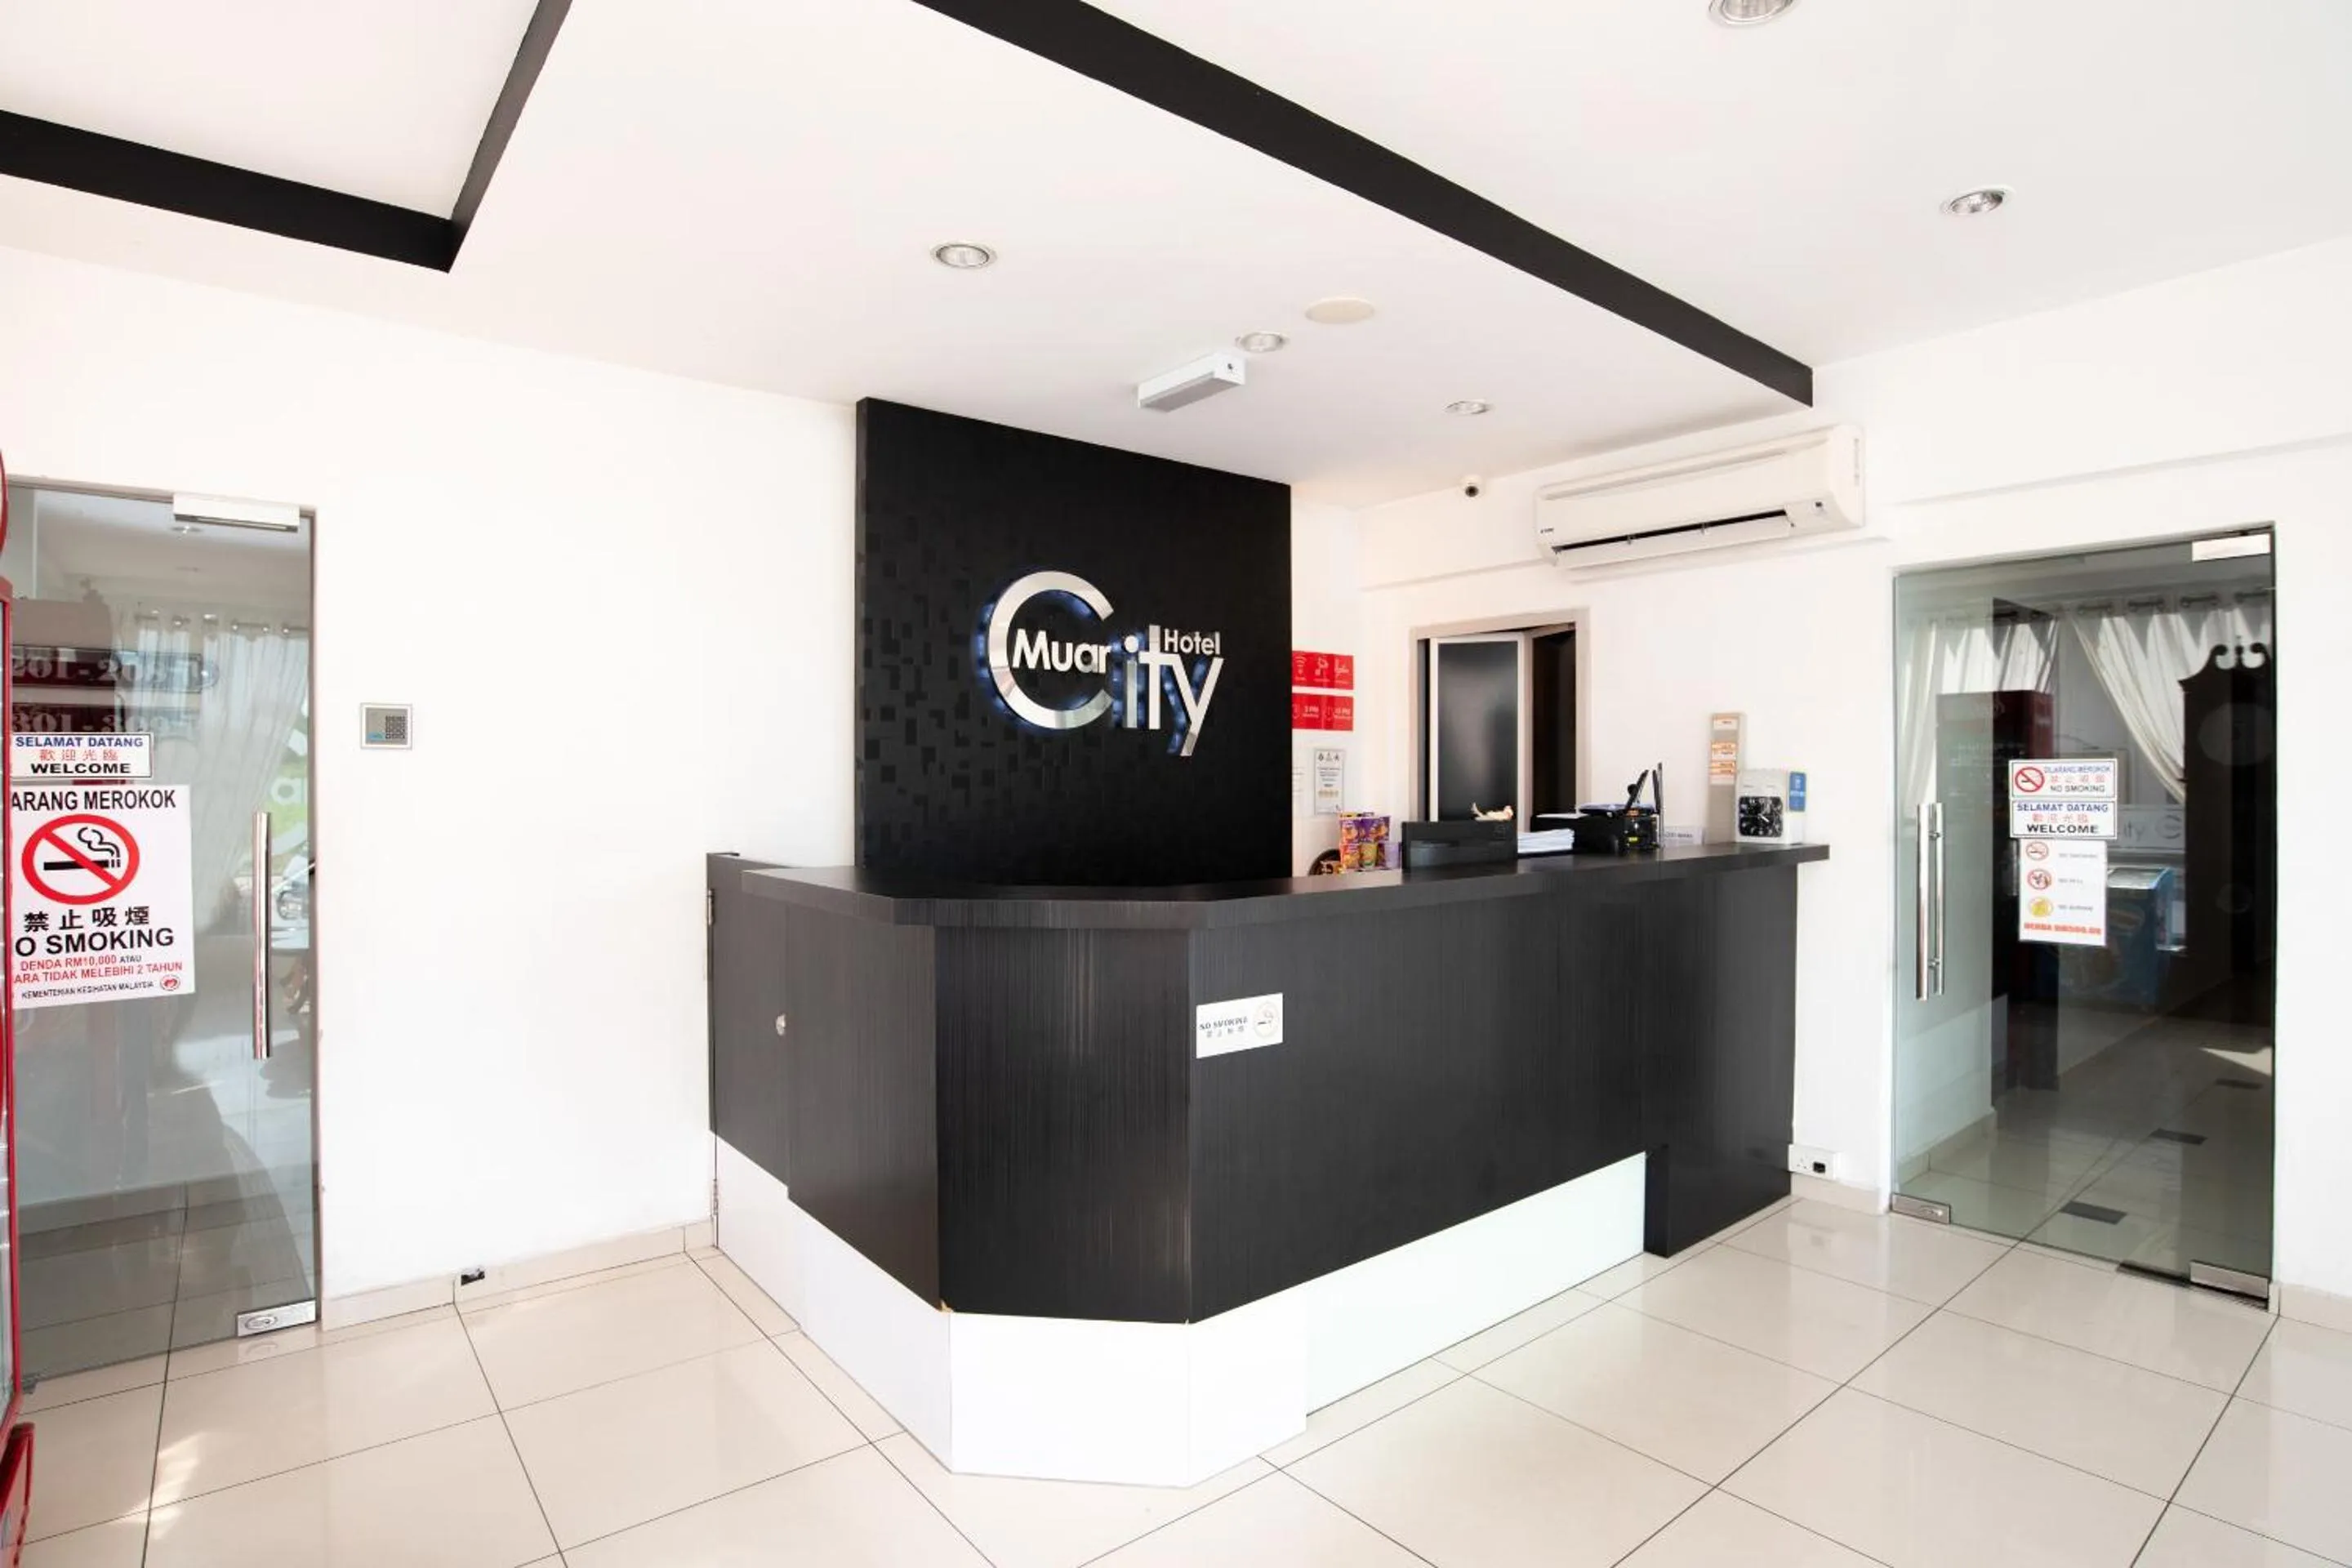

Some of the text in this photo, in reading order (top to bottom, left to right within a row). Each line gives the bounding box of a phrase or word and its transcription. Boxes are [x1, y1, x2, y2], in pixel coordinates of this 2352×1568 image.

[1013, 629, 1111, 674] Muar
[1165, 628, 1221, 655] Hotel
[988, 570, 1223, 756] City
[16, 737, 144, 747] SELAMAT DATANG
[30, 763, 131, 774] WELCOME
[12, 790, 176, 811] ARANG MEROKOK
[2017, 804, 2109, 813] SELAMAT DATANG
[2027, 824, 2098, 834] WELCOME
[24, 906, 149, 933] 禁止吸煙
[16, 928, 174, 956] O SMOKING
[20, 959, 62, 972] DENDA
[120, 955, 142, 964] ATAU
[42, 969, 78, 982] TIDAK
[82, 965, 134, 978] MELEBIHI
[137, 964, 144, 975] 2
[146, 961, 183, 973] TAHUN
